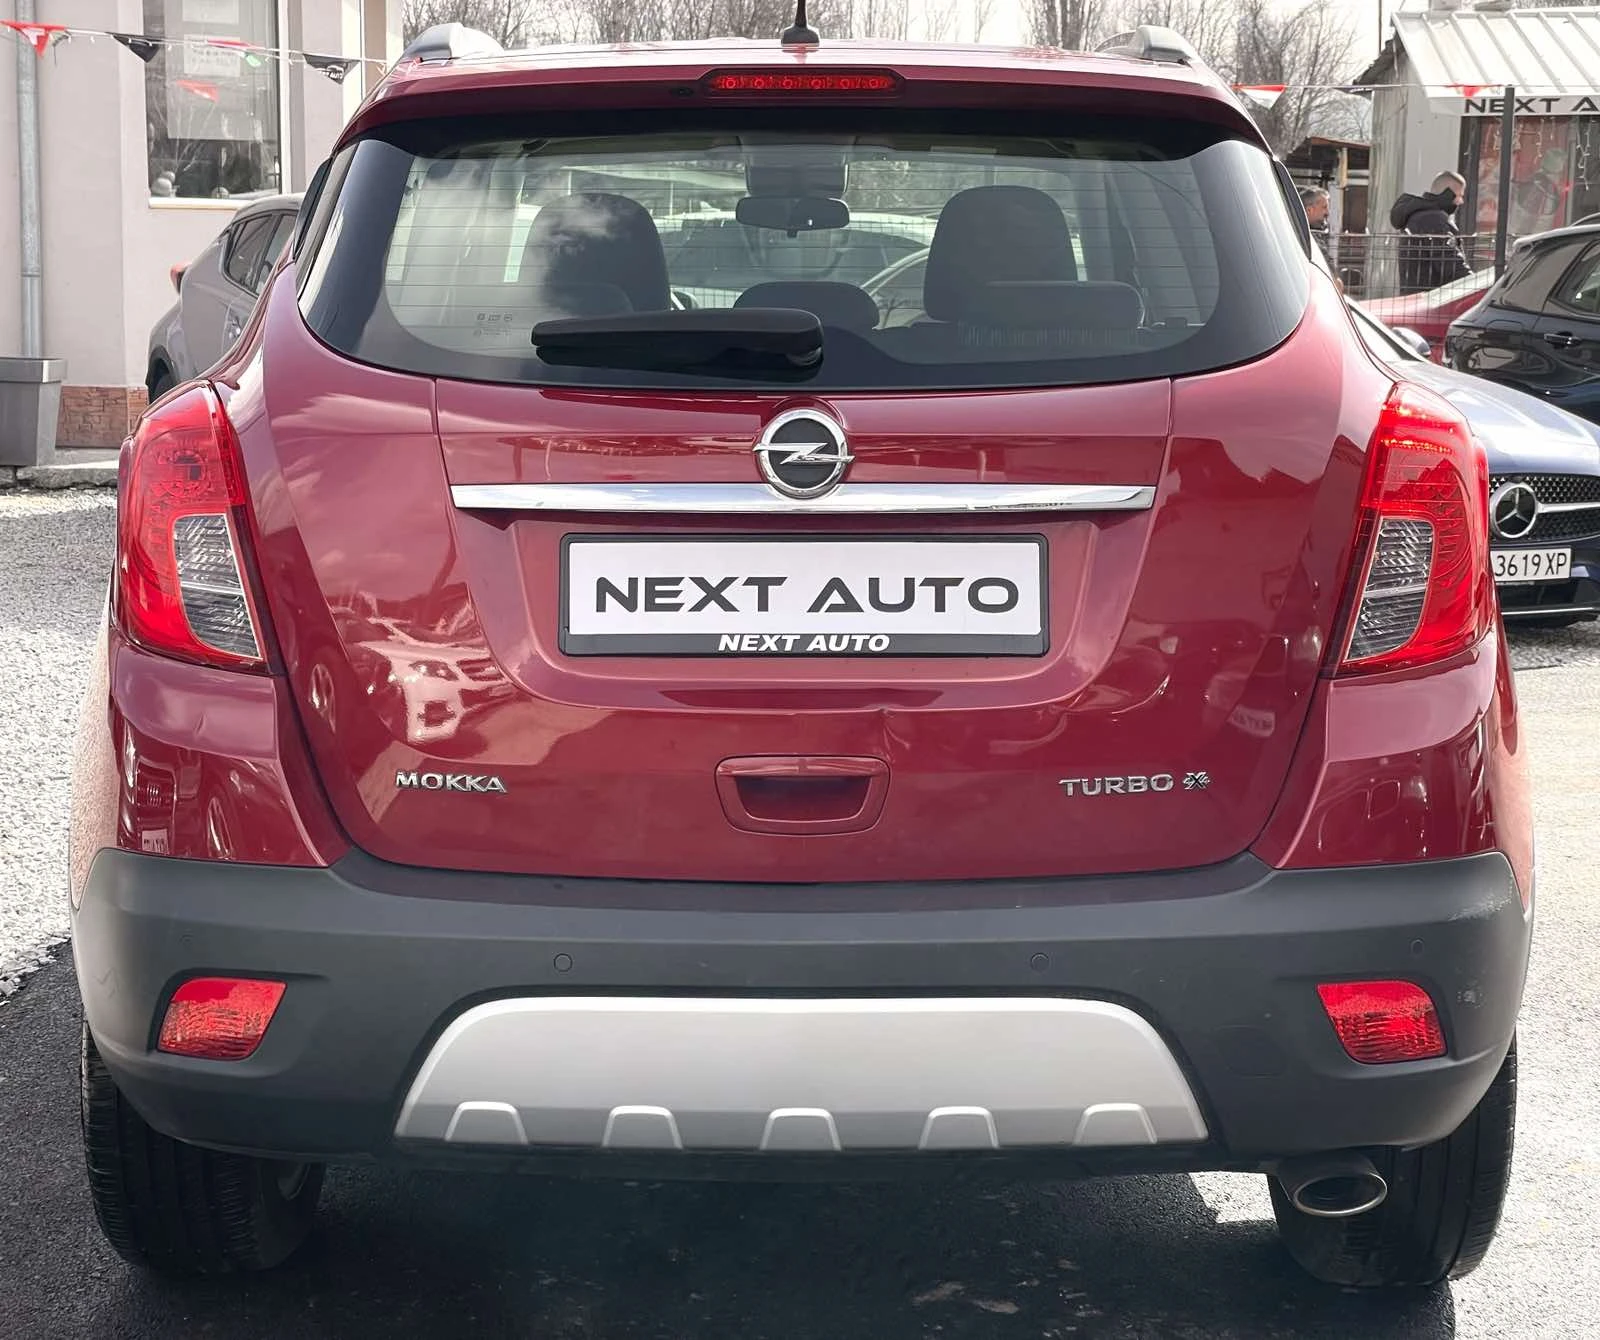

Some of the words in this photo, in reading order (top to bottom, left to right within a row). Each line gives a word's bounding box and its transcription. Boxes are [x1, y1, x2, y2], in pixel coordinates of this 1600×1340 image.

[1465, 97, 1560, 113] NEXT
[595, 576, 788, 613] NEXT
[806, 576, 1020, 613] AUTO
[717, 634, 801, 653] NEXT
[805, 634, 891, 653] AUTO
[395, 771, 507, 794] MOKKA
[1058, 772, 1175, 796] TURBO
